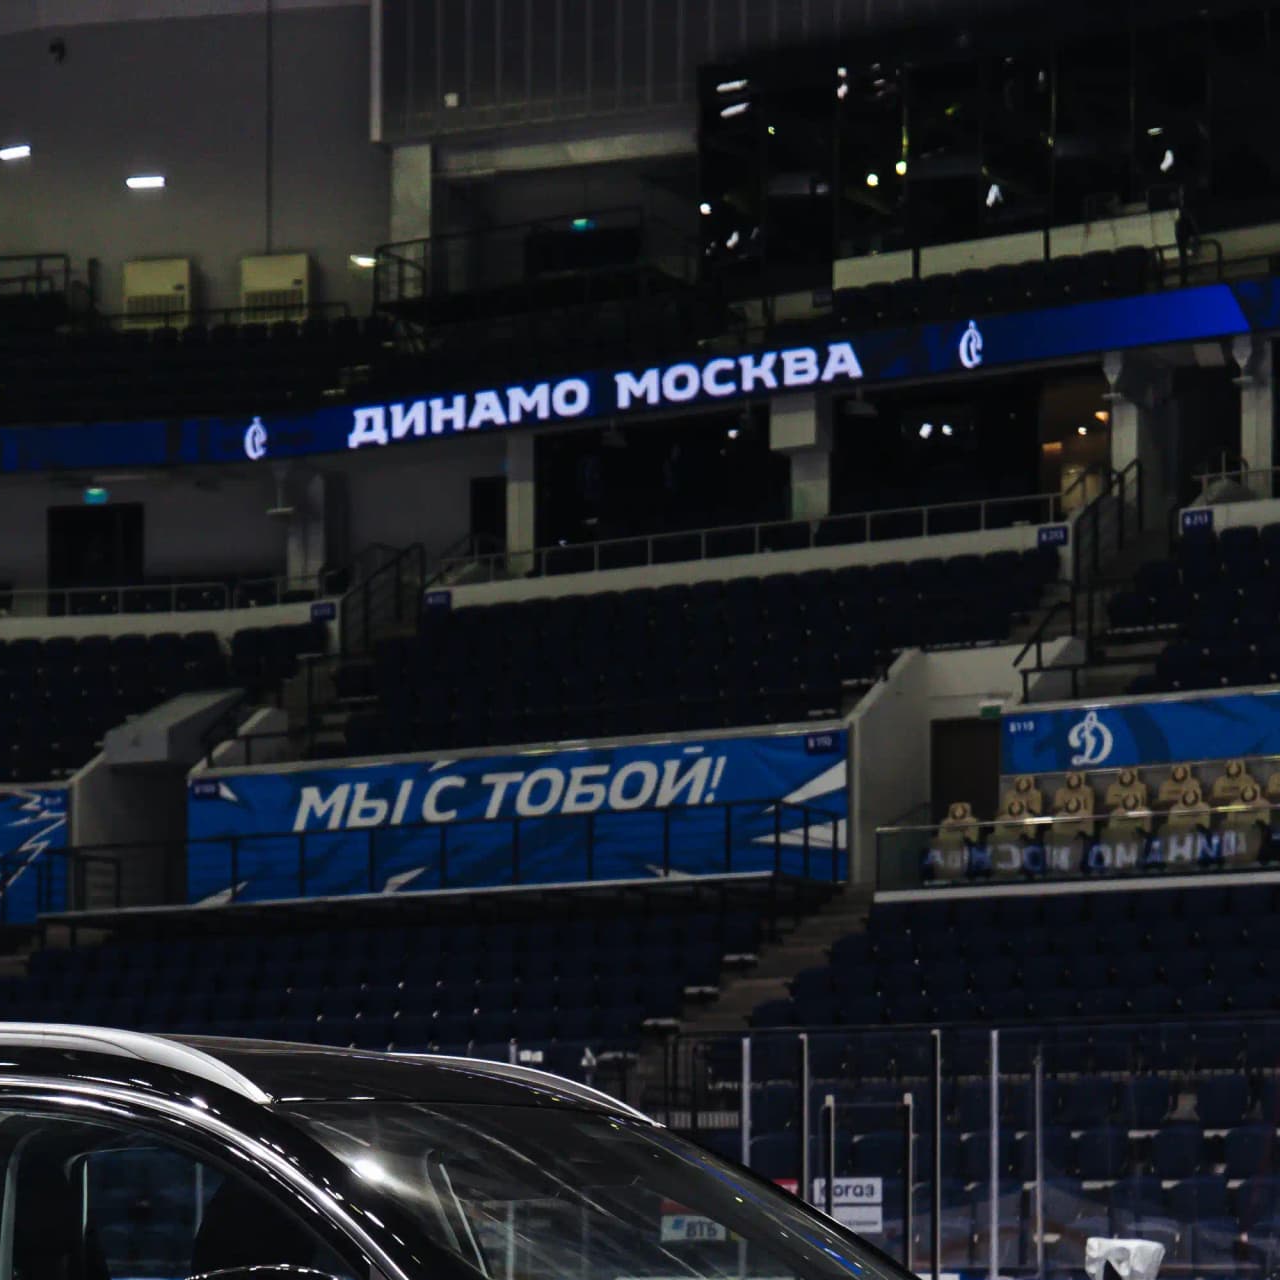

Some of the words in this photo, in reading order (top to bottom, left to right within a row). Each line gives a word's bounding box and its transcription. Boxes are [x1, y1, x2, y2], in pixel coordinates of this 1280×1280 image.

[348, 377, 591, 448] ДИНАМО
[614, 342, 864, 409] МОСКВА
[294, 780, 414, 832] МЫ
[422, 776, 466, 823] С
[481, 747, 728, 820] ТОБОЙ!
